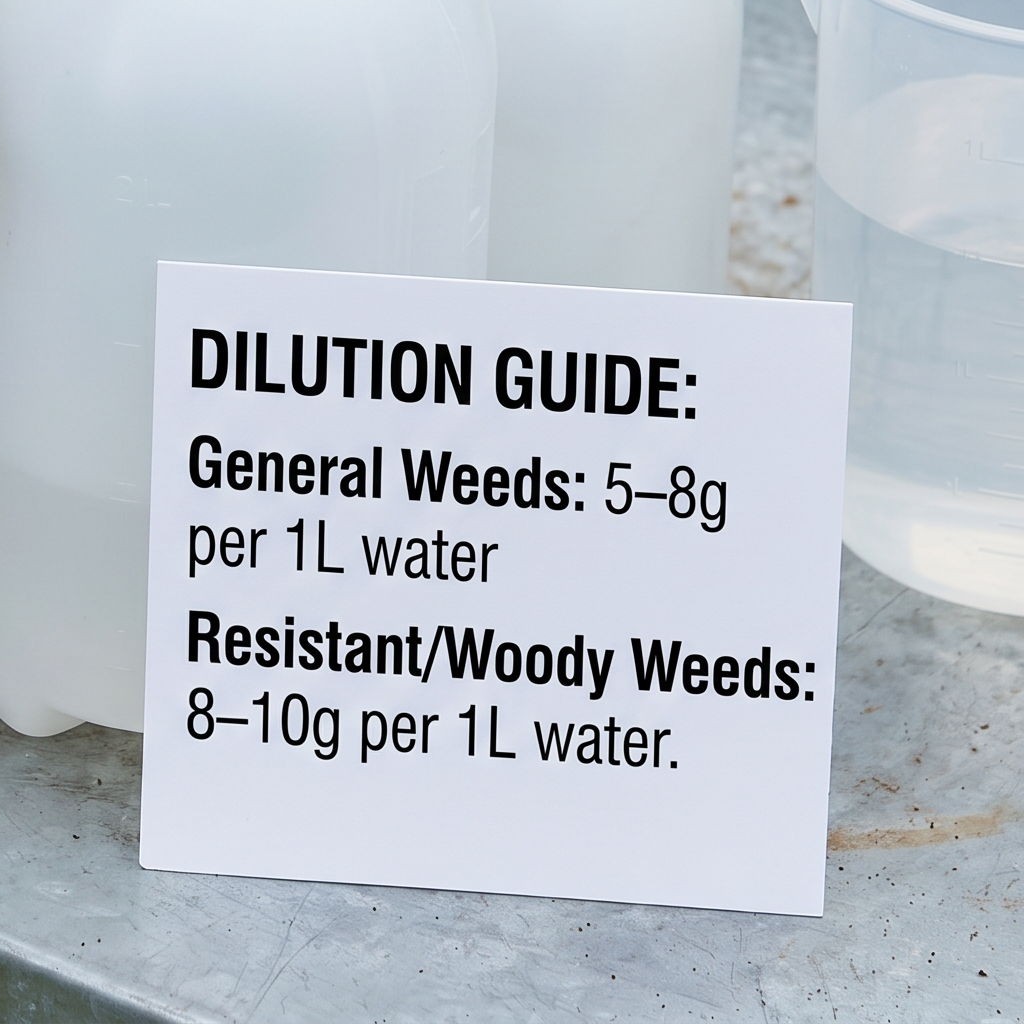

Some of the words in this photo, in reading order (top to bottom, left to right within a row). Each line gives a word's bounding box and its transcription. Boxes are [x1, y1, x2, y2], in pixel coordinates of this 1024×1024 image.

[192, 329, 471, 405] DILUTION
[496, 347, 696, 419] GUIDE:
[190, 435, 382, 498] General
[401, 449, 584, 511] Weeds:
[190, 526, 267, 577] per
[287, 519, 344, 573] 1L
[362, 530, 498, 582] water
[189, 610, 614, 701] Resistant/Woody
[631, 638, 815, 701] Weeds:
[362, 711, 439, 763] per
[459, 705, 516, 758] 1L
[534, 717, 677, 768] water.
